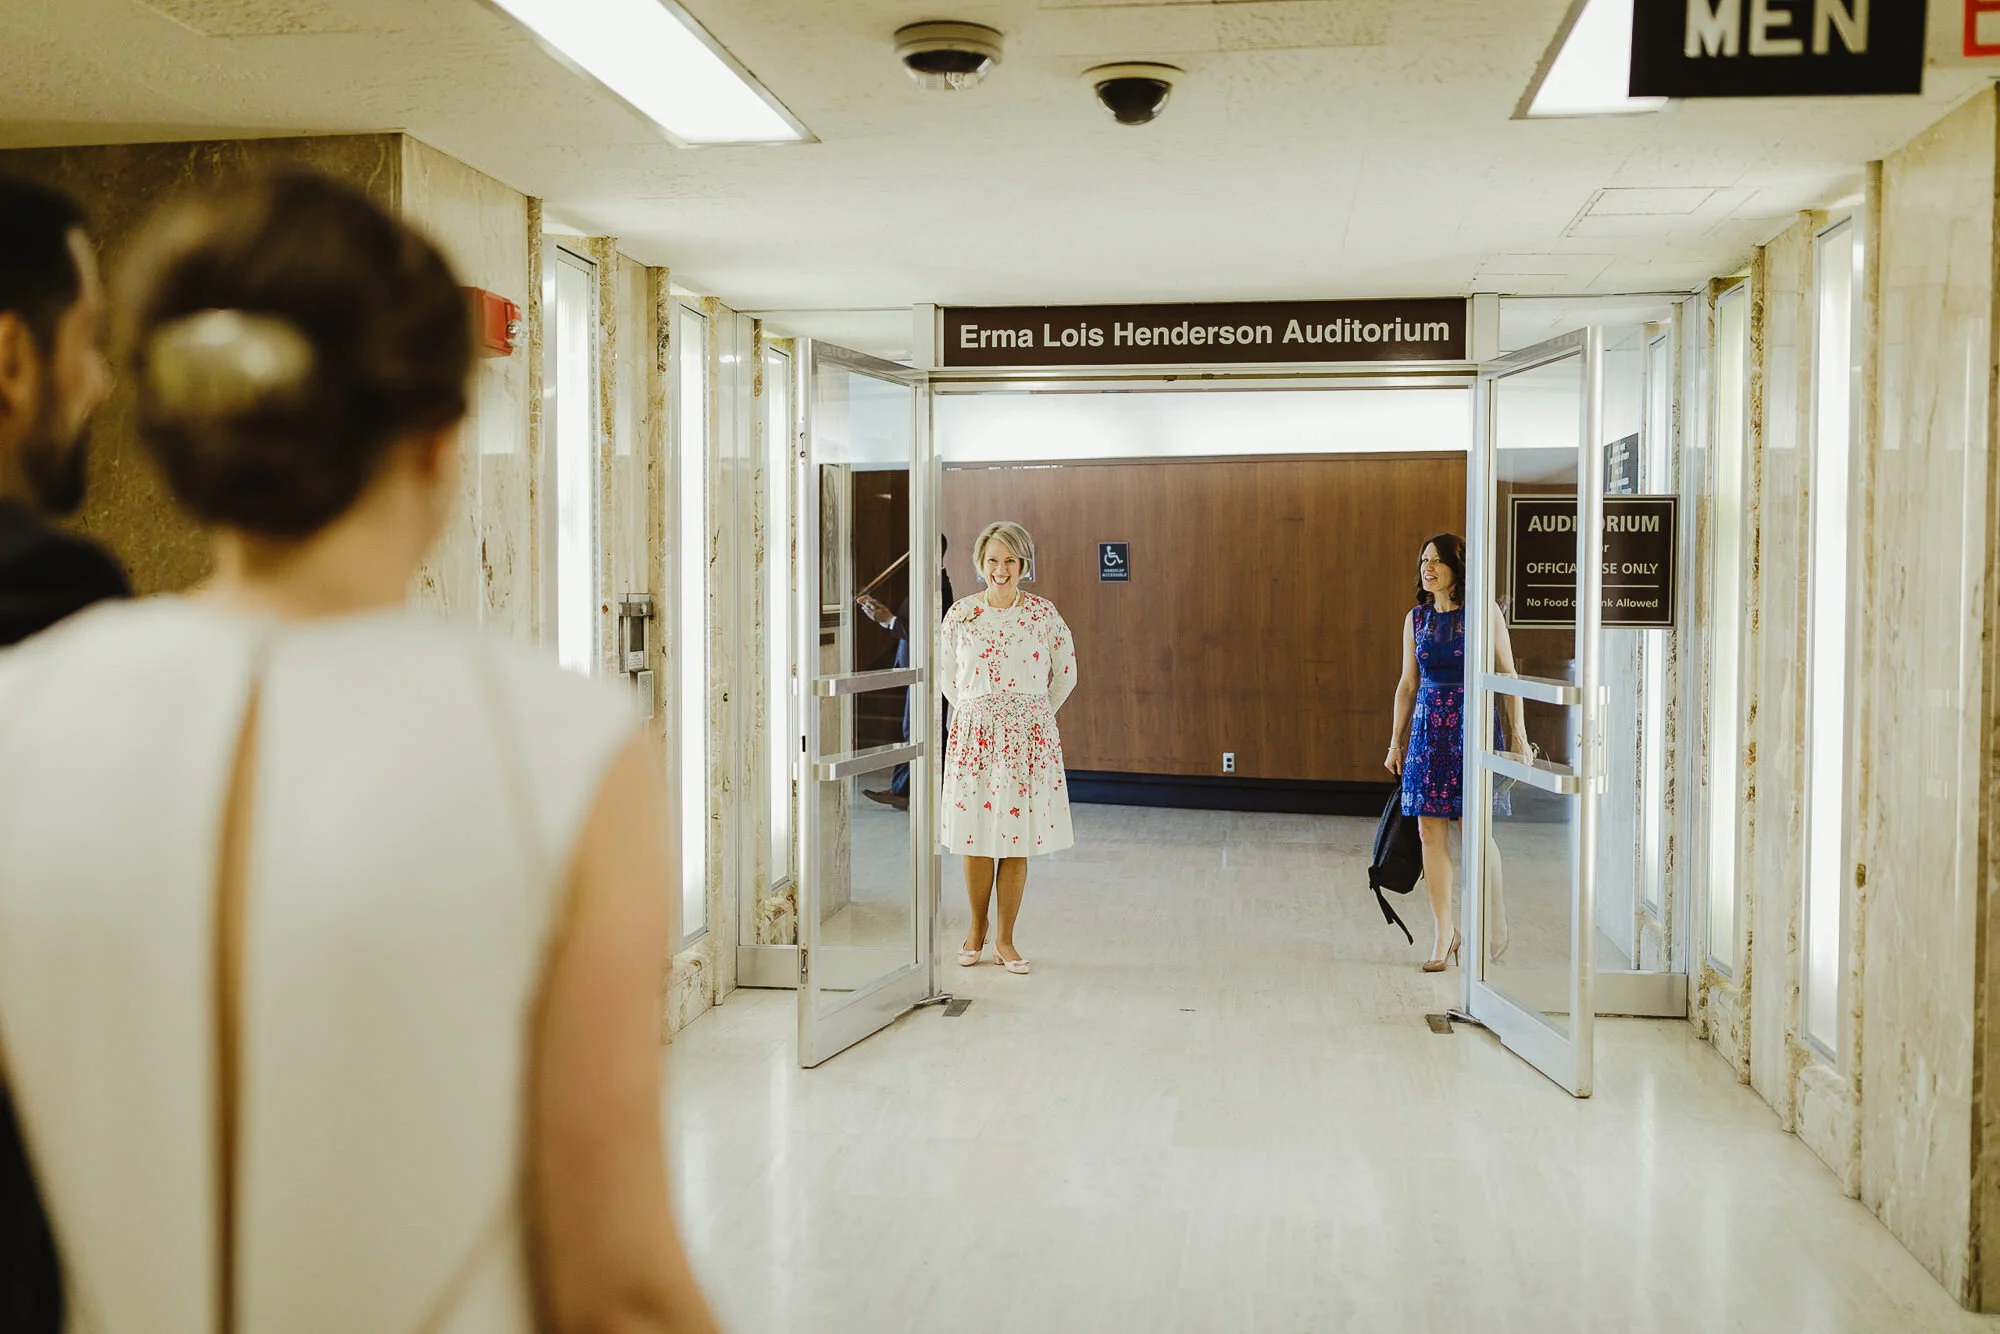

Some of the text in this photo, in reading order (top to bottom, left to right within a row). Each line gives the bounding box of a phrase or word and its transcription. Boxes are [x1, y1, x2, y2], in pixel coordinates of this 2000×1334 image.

[1684, 0, 1869, 58] MEN
[960, 317, 1450, 349] Erma Lois Henderson Auditorium
[1527, 514, 1660, 532] AUDIRIUM
[1526, 562, 1659, 575] OFFICIA SE ONLY
[1526, 598, 1541, 607] No
[1543, 598, 1569, 607] Food
[1615, 598, 1659, 608] Allowed
